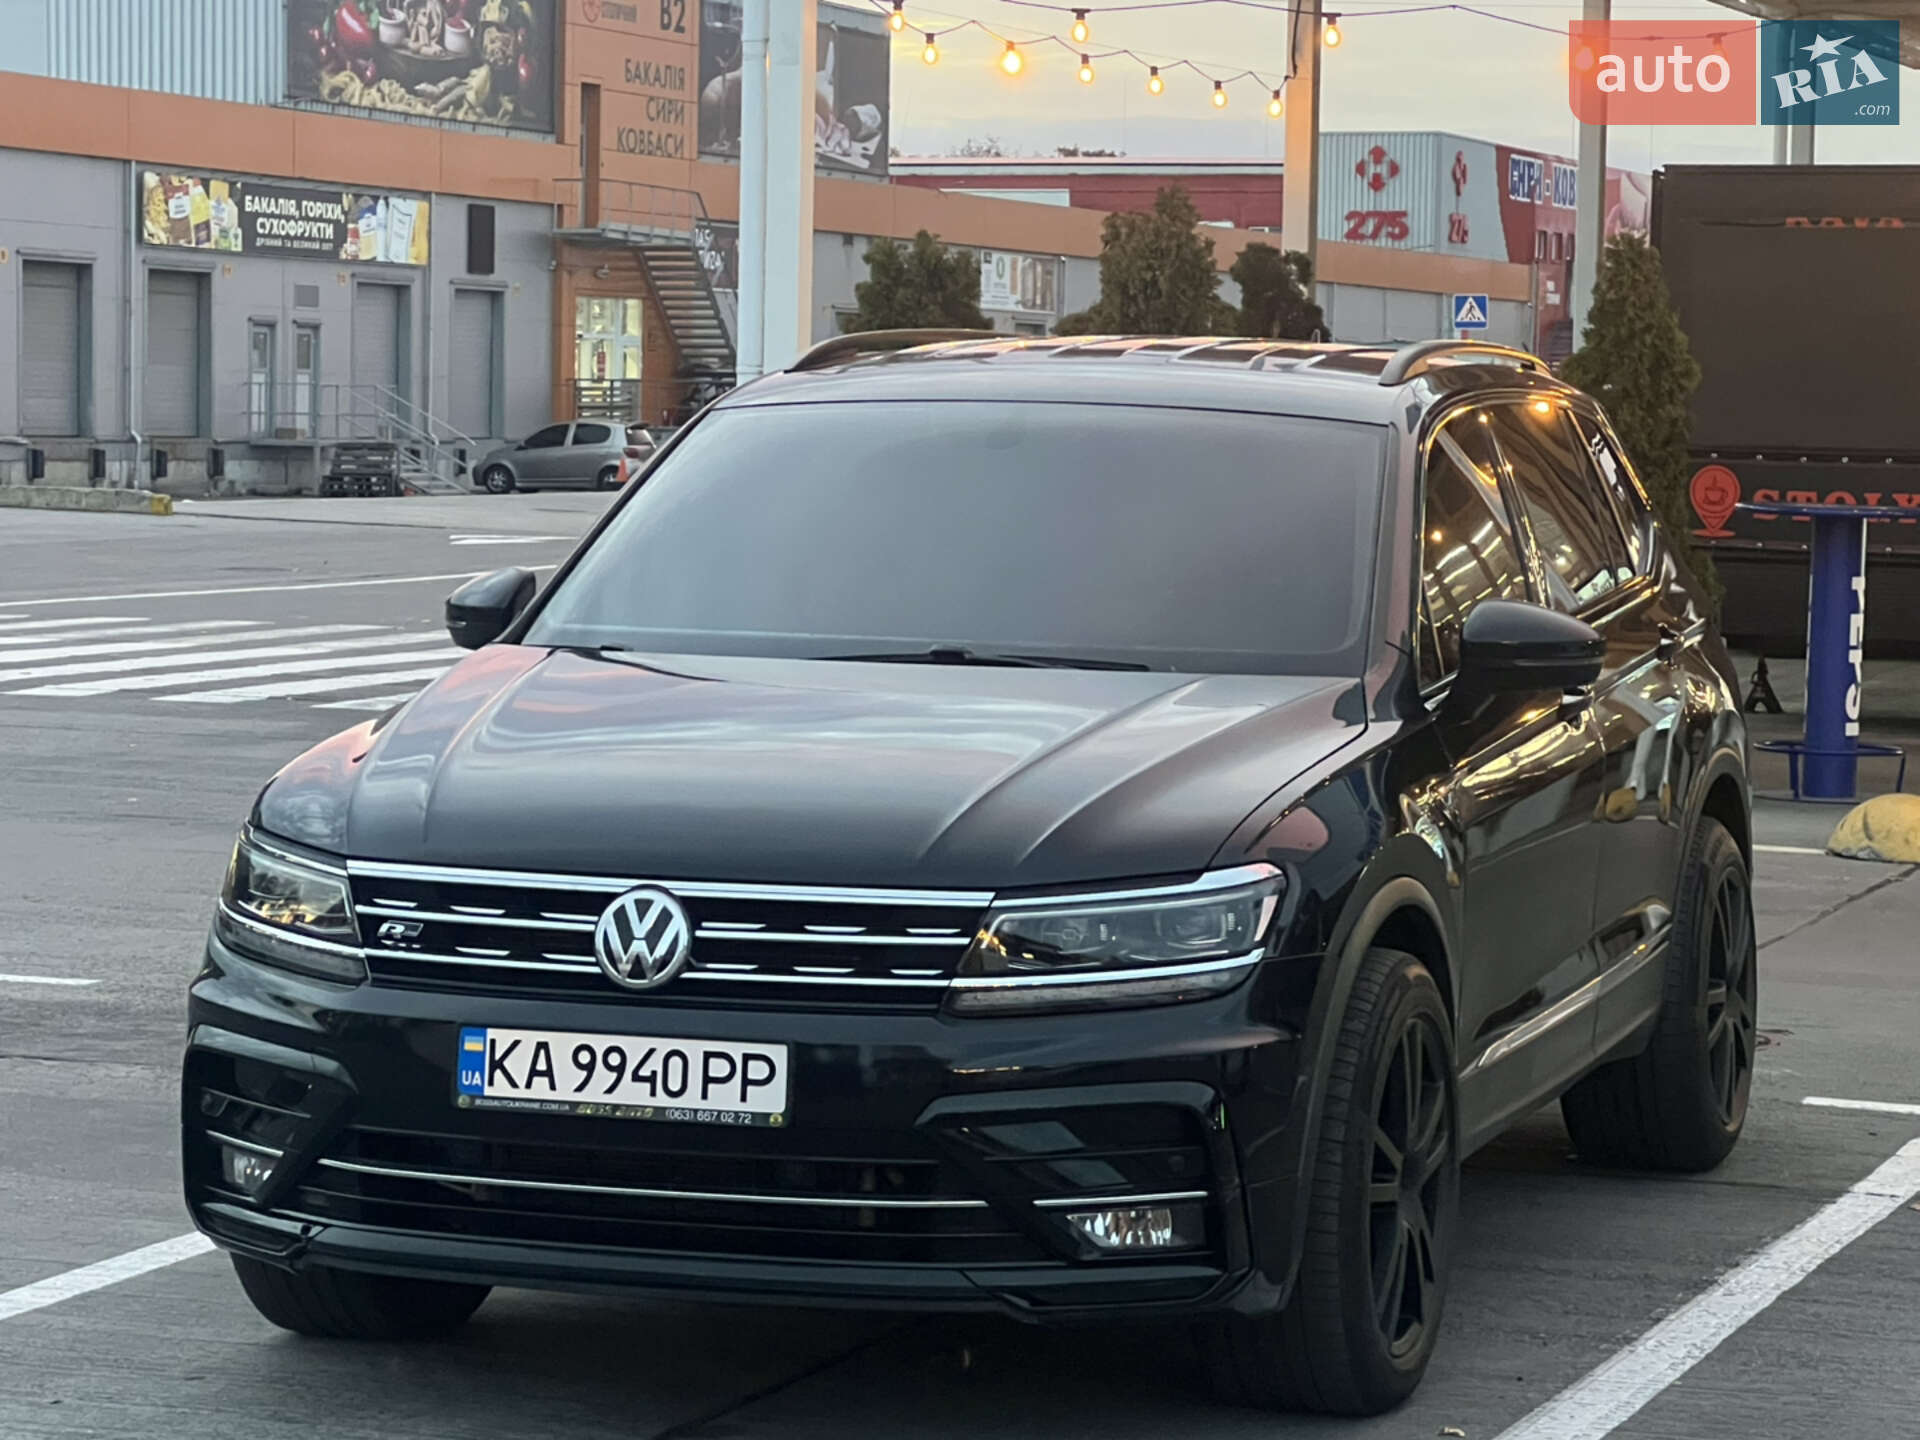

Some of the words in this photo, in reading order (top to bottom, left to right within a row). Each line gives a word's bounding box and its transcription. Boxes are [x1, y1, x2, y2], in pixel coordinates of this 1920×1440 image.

[624, 58, 685, 91] БАКАЛІЯ
[646, 96, 685, 126] СИРИ
[616, 126, 685, 159] КОВБАСИ
[244, 194, 300, 219] БАКАЛІЯ,
[301, 200, 345, 224] ГОРІХИ,
[256, 217, 334, 239] СУХОФРУКТИ
[1344, 210, 1409, 241] 275
[461, 1070, 483, 1088] UA
[487, 1038, 557, 1092] KA
[571, 1043, 689, 1099] 9940
[700, 1050, 777, 1104] PP
[665, 1107, 694, 1121] (063)
[720, 1111, 735, 1123] 02
[738, 1112, 753, 1125] 72
